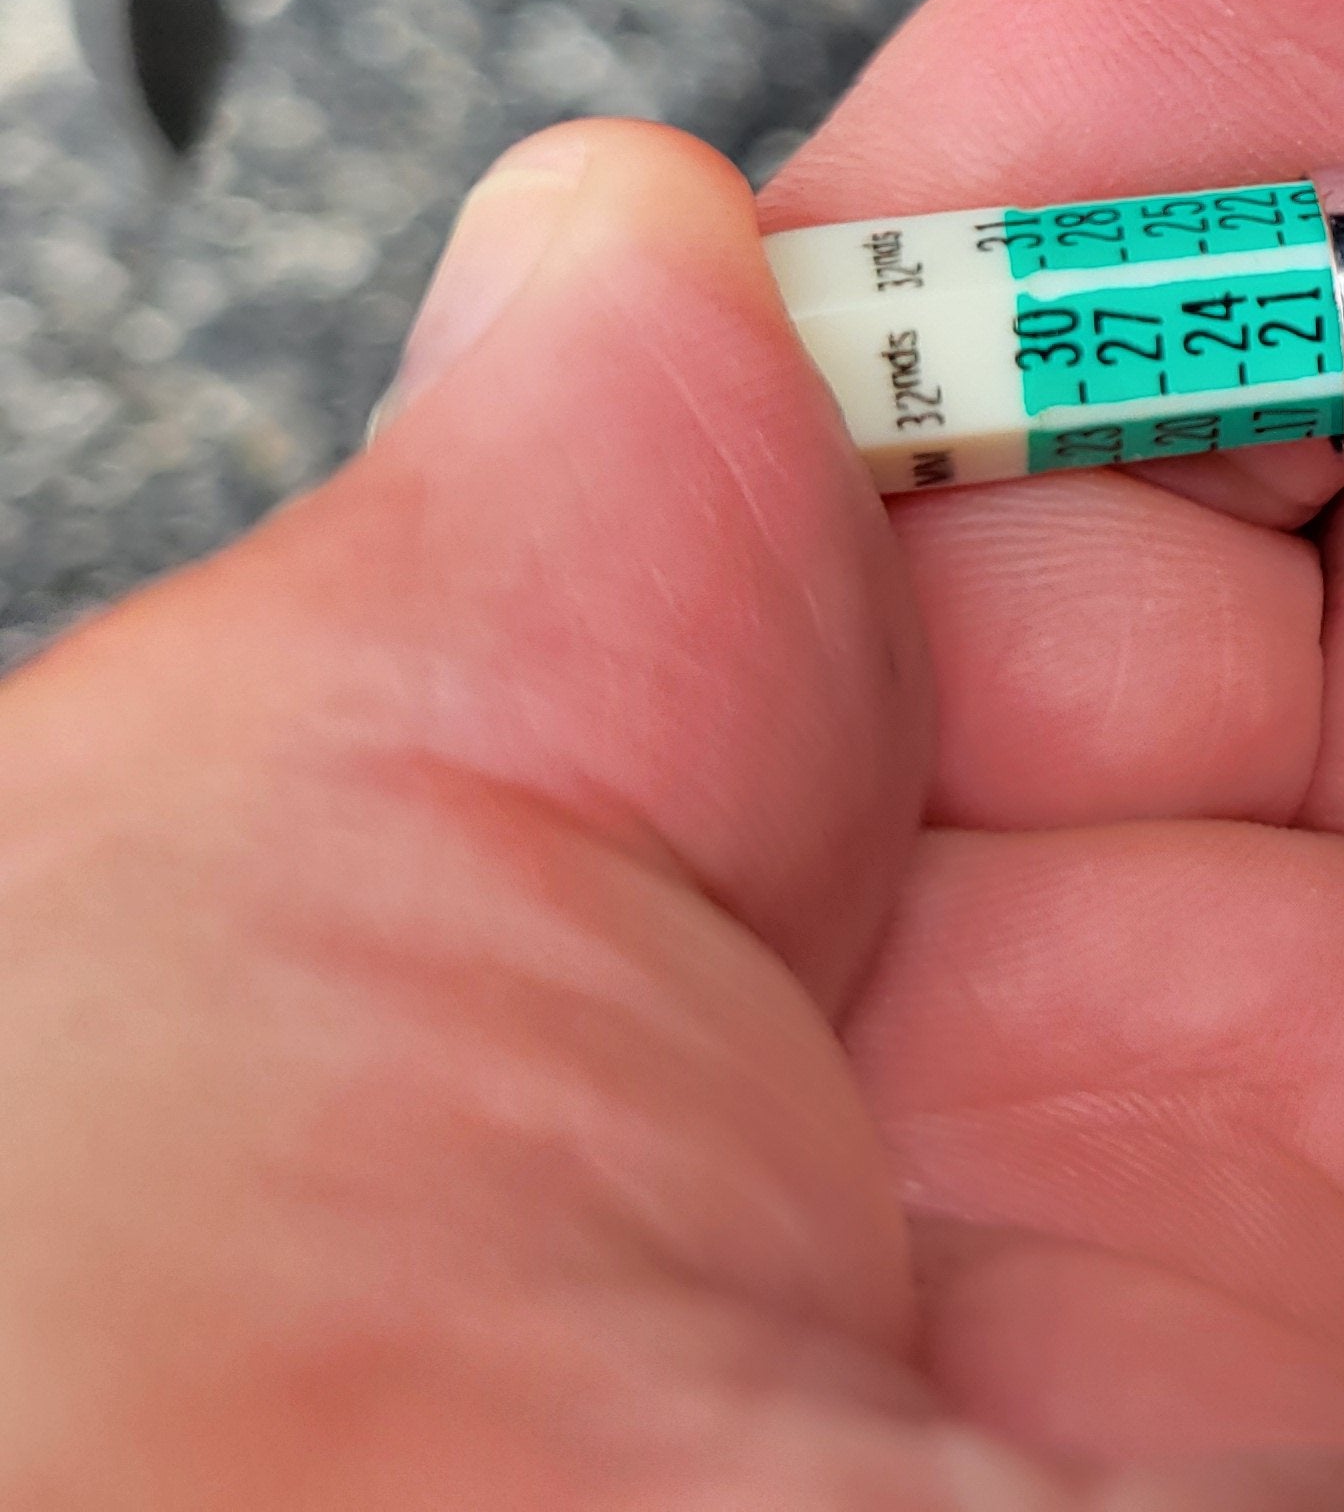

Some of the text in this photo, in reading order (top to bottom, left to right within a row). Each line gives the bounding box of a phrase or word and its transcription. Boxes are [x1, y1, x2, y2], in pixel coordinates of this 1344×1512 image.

[1054, 207, 1125, 247] 28
[1140, 199, 1210, 239] 25
[1214, 190, 1284, 231] 22
[974, 217, 1045, 253] 31
[864, 229, 925, 292] 32nds
[1092, 307, 1165, 367] 27
[1180, 291, 1250, 357] 24
[1255, 286, 1326, 349] 21
[1012, 306, 1083, 372] 30
[881, 329, 946, 432] 32nds
[1055, 423, 1124, 457] 23
[1152, 414, 1221, 446] 20
[1252, 406, 1322, 434] 17
